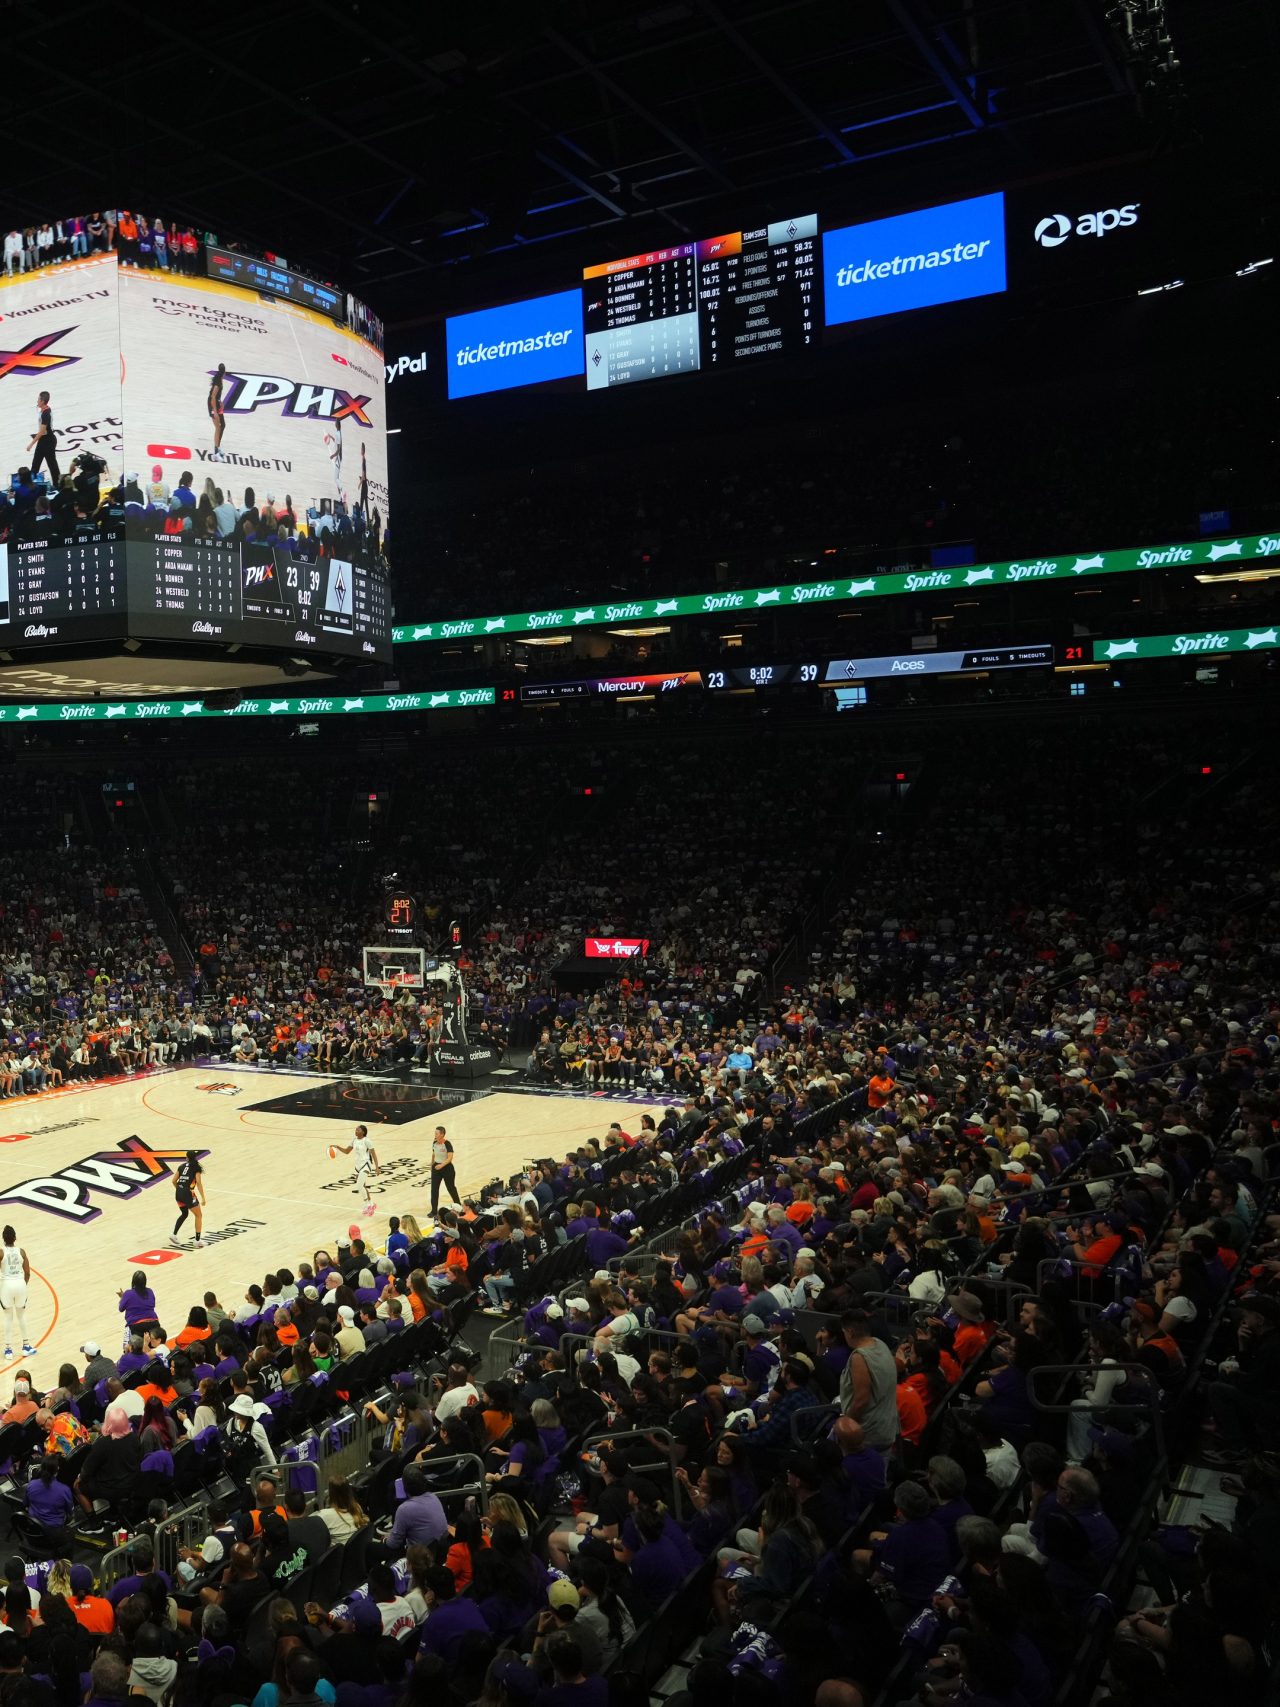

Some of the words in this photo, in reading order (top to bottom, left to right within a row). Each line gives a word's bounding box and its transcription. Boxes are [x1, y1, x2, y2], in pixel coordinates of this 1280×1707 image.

[1076, 205, 1137, 238] aps
[837, 241, 989, 286] ticketmaster
[3, 298, 82, 321] YouTube
[83, 289, 110, 305] TV
[152, 297, 265, 327] mortgage
[188, 312, 268, 335] matchup
[195, 320, 241, 333] center
[457, 330, 572, 365] ticketmaster
[206, 370, 374, 428] PHX
[272, 458, 292, 473] TV
[17, 541, 35, 550] PLAYER
[34, 540, 48, 549] STATS
[27, 554, 44, 564] SMITH
[1137, 548, 1191, 567] Sprite
[28, 567, 45, 577] EVANS
[243, 562, 274, 589] PHX
[286, 567, 298, 587] 23
[310, 571, 320, 591] 39
[1007, 562, 1056, 581] Sprite
[28, 580, 42, 589] GRAY
[904, 572, 950, 591] Sprite
[28, 591, 59, 602] GUSTAFSON
[298, 590, 312, 606] 8:02
[792, 584, 834, 602] Sprite
[703, 594, 743, 611] Sprite
[29, 606, 43, 615] LOYD
[302, 609, 308, 620] 21
[605, 604, 642, 621] Sprite
[192, 620, 215, 636] Bally
[527, 613, 562, 628] Sprite
[24, 624, 48, 637] Bally
[441, 622, 474, 637] Sprite
[1172, 634, 1228, 654] Sprite
[1018, 652, 1046, 660] TIMEOUTS
[1066, 647, 1082, 659] 21
[800, 665, 817, 681] 39
[891, 659, 925, 672] Aces
[708, 672, 724, 688] 23
[749, 667, 773, 680] 8:02
[598, 680, 645, 694] Mercury
[661, 674, 689, 691] PHX
[387, 696, 420, 710] Sprite
[458, 690, 492, 705] Sprite
[503, 690, 515, 701] 21
[60, 706, 95, 719] Sprite
[136, 704, 170, 717] Sprite
[298, 699, 332, 713] Sprite
[394, 899, 410, 908] 8:02
[391, 908, 410, 923] 21
[268, 1371, 281, 1390] 22
